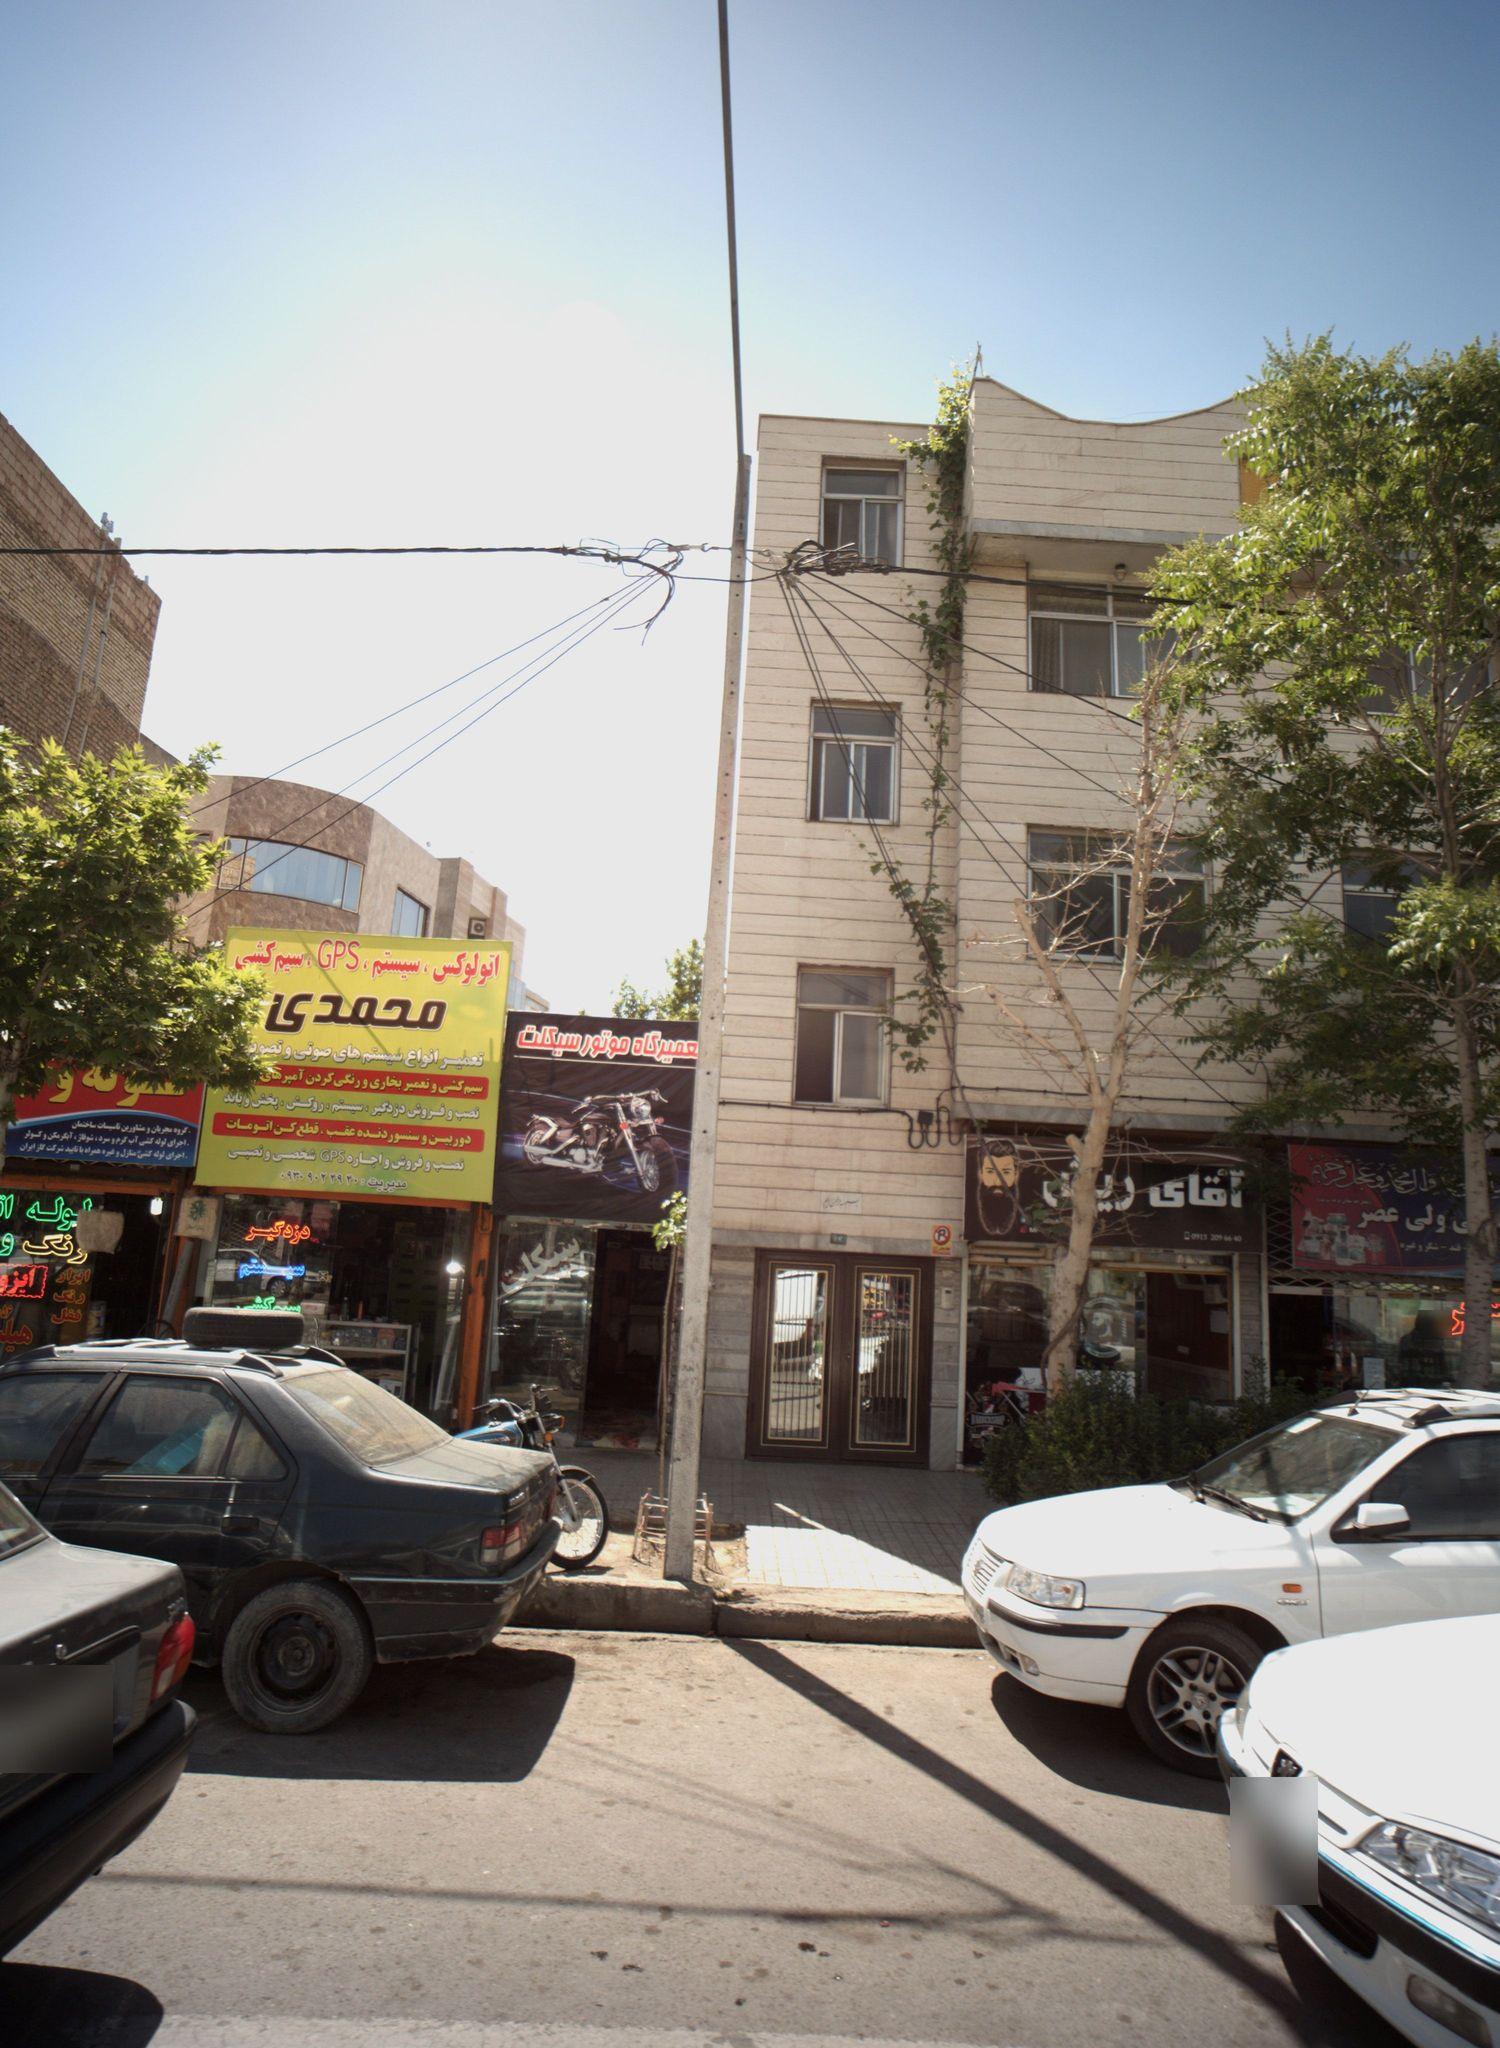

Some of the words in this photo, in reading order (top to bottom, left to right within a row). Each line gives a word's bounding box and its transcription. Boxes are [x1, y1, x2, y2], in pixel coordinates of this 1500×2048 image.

[317, 939, 361, 971] GPS
[371, 951, 421, 979] سیستم
[432, 952, 500, 986] اتولوکس
[264, 992, 447, 1034] محمدی
[517, 1025, 582, 1057] سیکلت
[580, 1029, 631, 1059] موتور
[632, 1031, 699, 1063] عمیرگاه
[284, 1047, 292, 1060] و
[293, 1042, 332, 1060] صوتی
[333, 1044, 361, 1062] های
[362, 1047, 403, 1064] سیستم
[404, 1048, 439, 1068] انواع
[440, 1051, 484, 1069] تعمیر
[282, 1069, 304, 1084] آمپر
[363, 1079, 368, 1089] و
[369, 1075, 402, 1090] بخاری
[404, 1079, 430, 1092] تعمیر
[431, 1084, 438, 1093] و
[251, 1093, 279, 1110] پخش
[285, 1095, 323, 1112] روکش
[331, 1099, 363, 1114] سیستم
[371, 1102, 406, 1117] دزدگیر
[407, 1104, 445, 1120] فروش
[447, 1110, 453, 1120] و
[455, 1107, 480, 1121] نصب
[72, 1120, 96, 1129] ساختمان
[121, 1124, 145, 1132] مشاورین
[151, 1125, 172, 1134] مجریان
[174, 1126, 188, 1136] گروه
[226, 1118, 273, 1134] اتومات
[273, 1122, 297, 1135] کن
[296, 1121, 319, 1137] قطع
[326, 1125, 355, 1139] عقب
[357, 1127, 388, 1139] دنده
[388, 1130, 420, 1144] سنسور
[421, 1135, 427, 1145] و
[429, 1134, 472, 1147] دوربین
[167, 1139, 186, 1148] اجرای
[227, 1145, 263, 1159] نصبی
[264, 1150, 270, 1160] و
[272, 1148, 315, 1162] شخصی
[320, 1149, 346, 1163] GPS
[347, 1152, 382, 1168] اجاره
[383, 1158, 390, 1169] و
[391, 1153, 423, 1171] فروش
[424, 1161, 430, 1172] و
[432, 1160, 464, 1173] نصب
[367, 1177, 407, 1192] مدیریت
[1149, 1168, 1245, 1209] آقای
[1357, 1206, 1399, 1228] عصر
[1405, 1204, 1446, 1233] ولی
[245, 1220, 311, 1245] دزدگیر
[23, 1234, 88, 1264] رنگ
[238, 1258, 305, 1280] سیستم
[53, 1290, 85, 1305] رنگ
[51, 1307, 82, 1325] قفل
